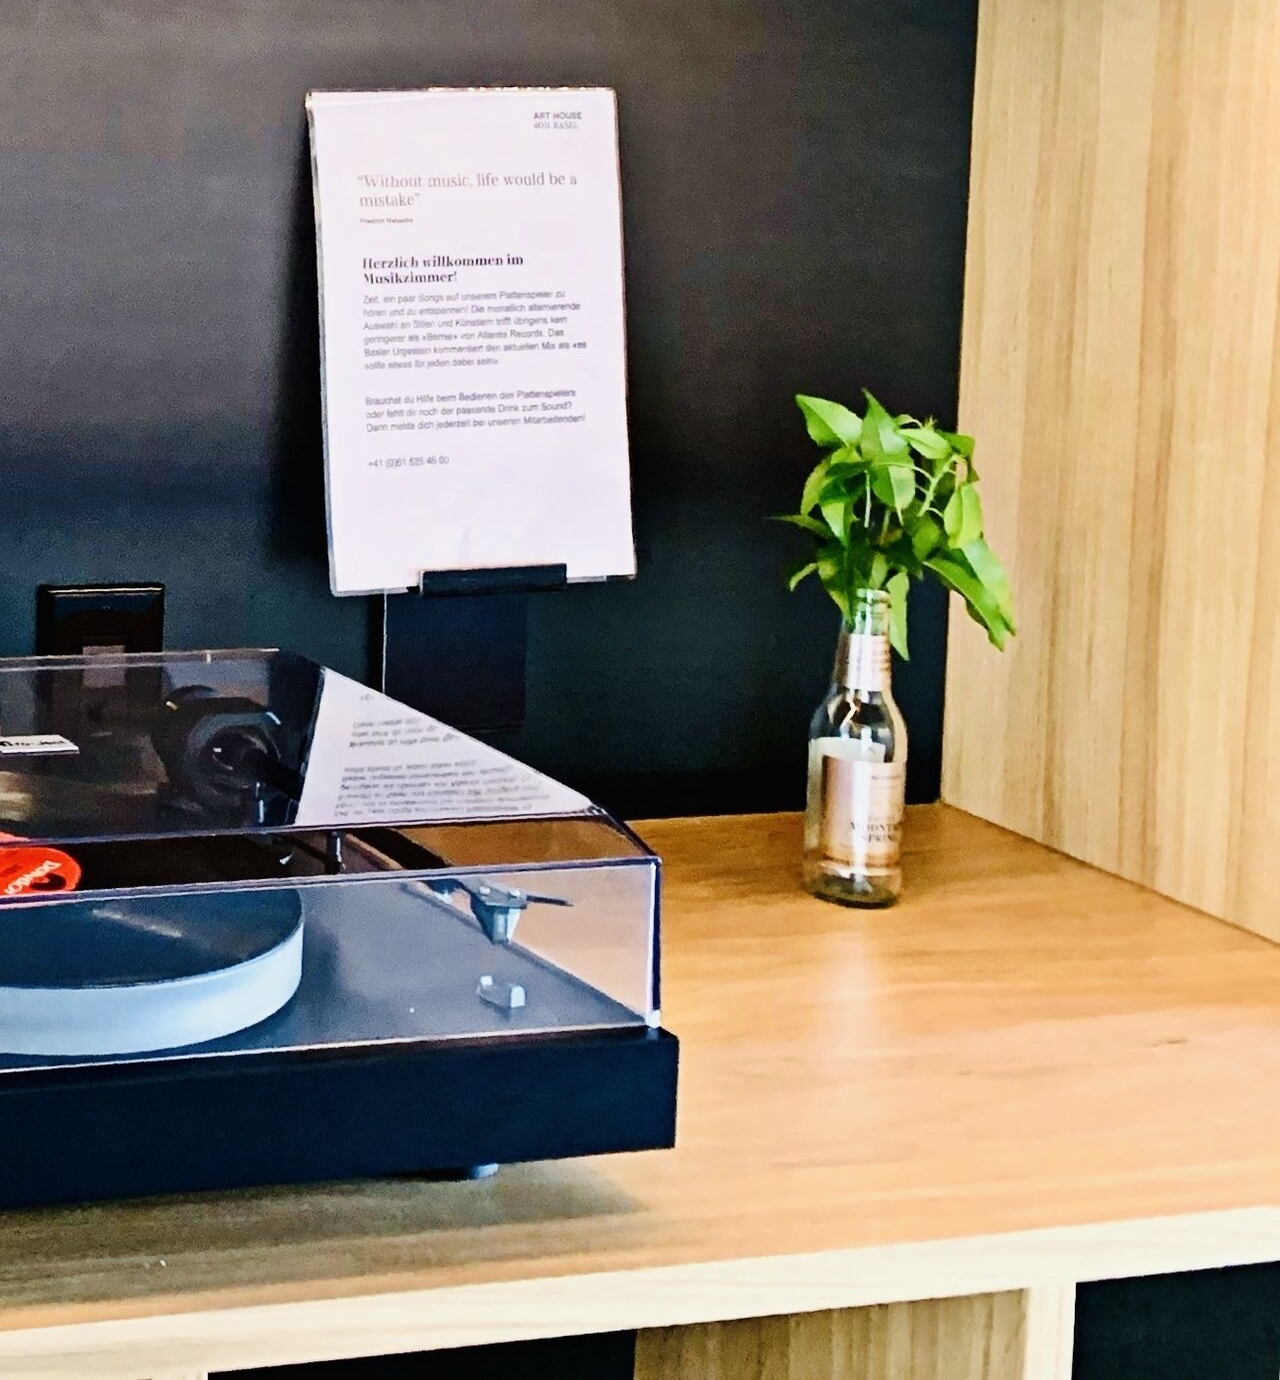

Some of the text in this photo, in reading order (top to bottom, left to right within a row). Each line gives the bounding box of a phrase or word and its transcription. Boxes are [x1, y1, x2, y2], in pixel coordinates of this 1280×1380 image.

[534, 111, 582, 120] ART HOUSE
[476, 172, 499, 187] life
[504, 172, 545, 186] would
[549, 172, 566, 186] be
[569, 175, 578, 185] a
[362, 254, 524, 270] Herzlich willkommen im
[364, 271, 457, 284] Musikzimmer!
[418, 293, 444, 303] Songs
